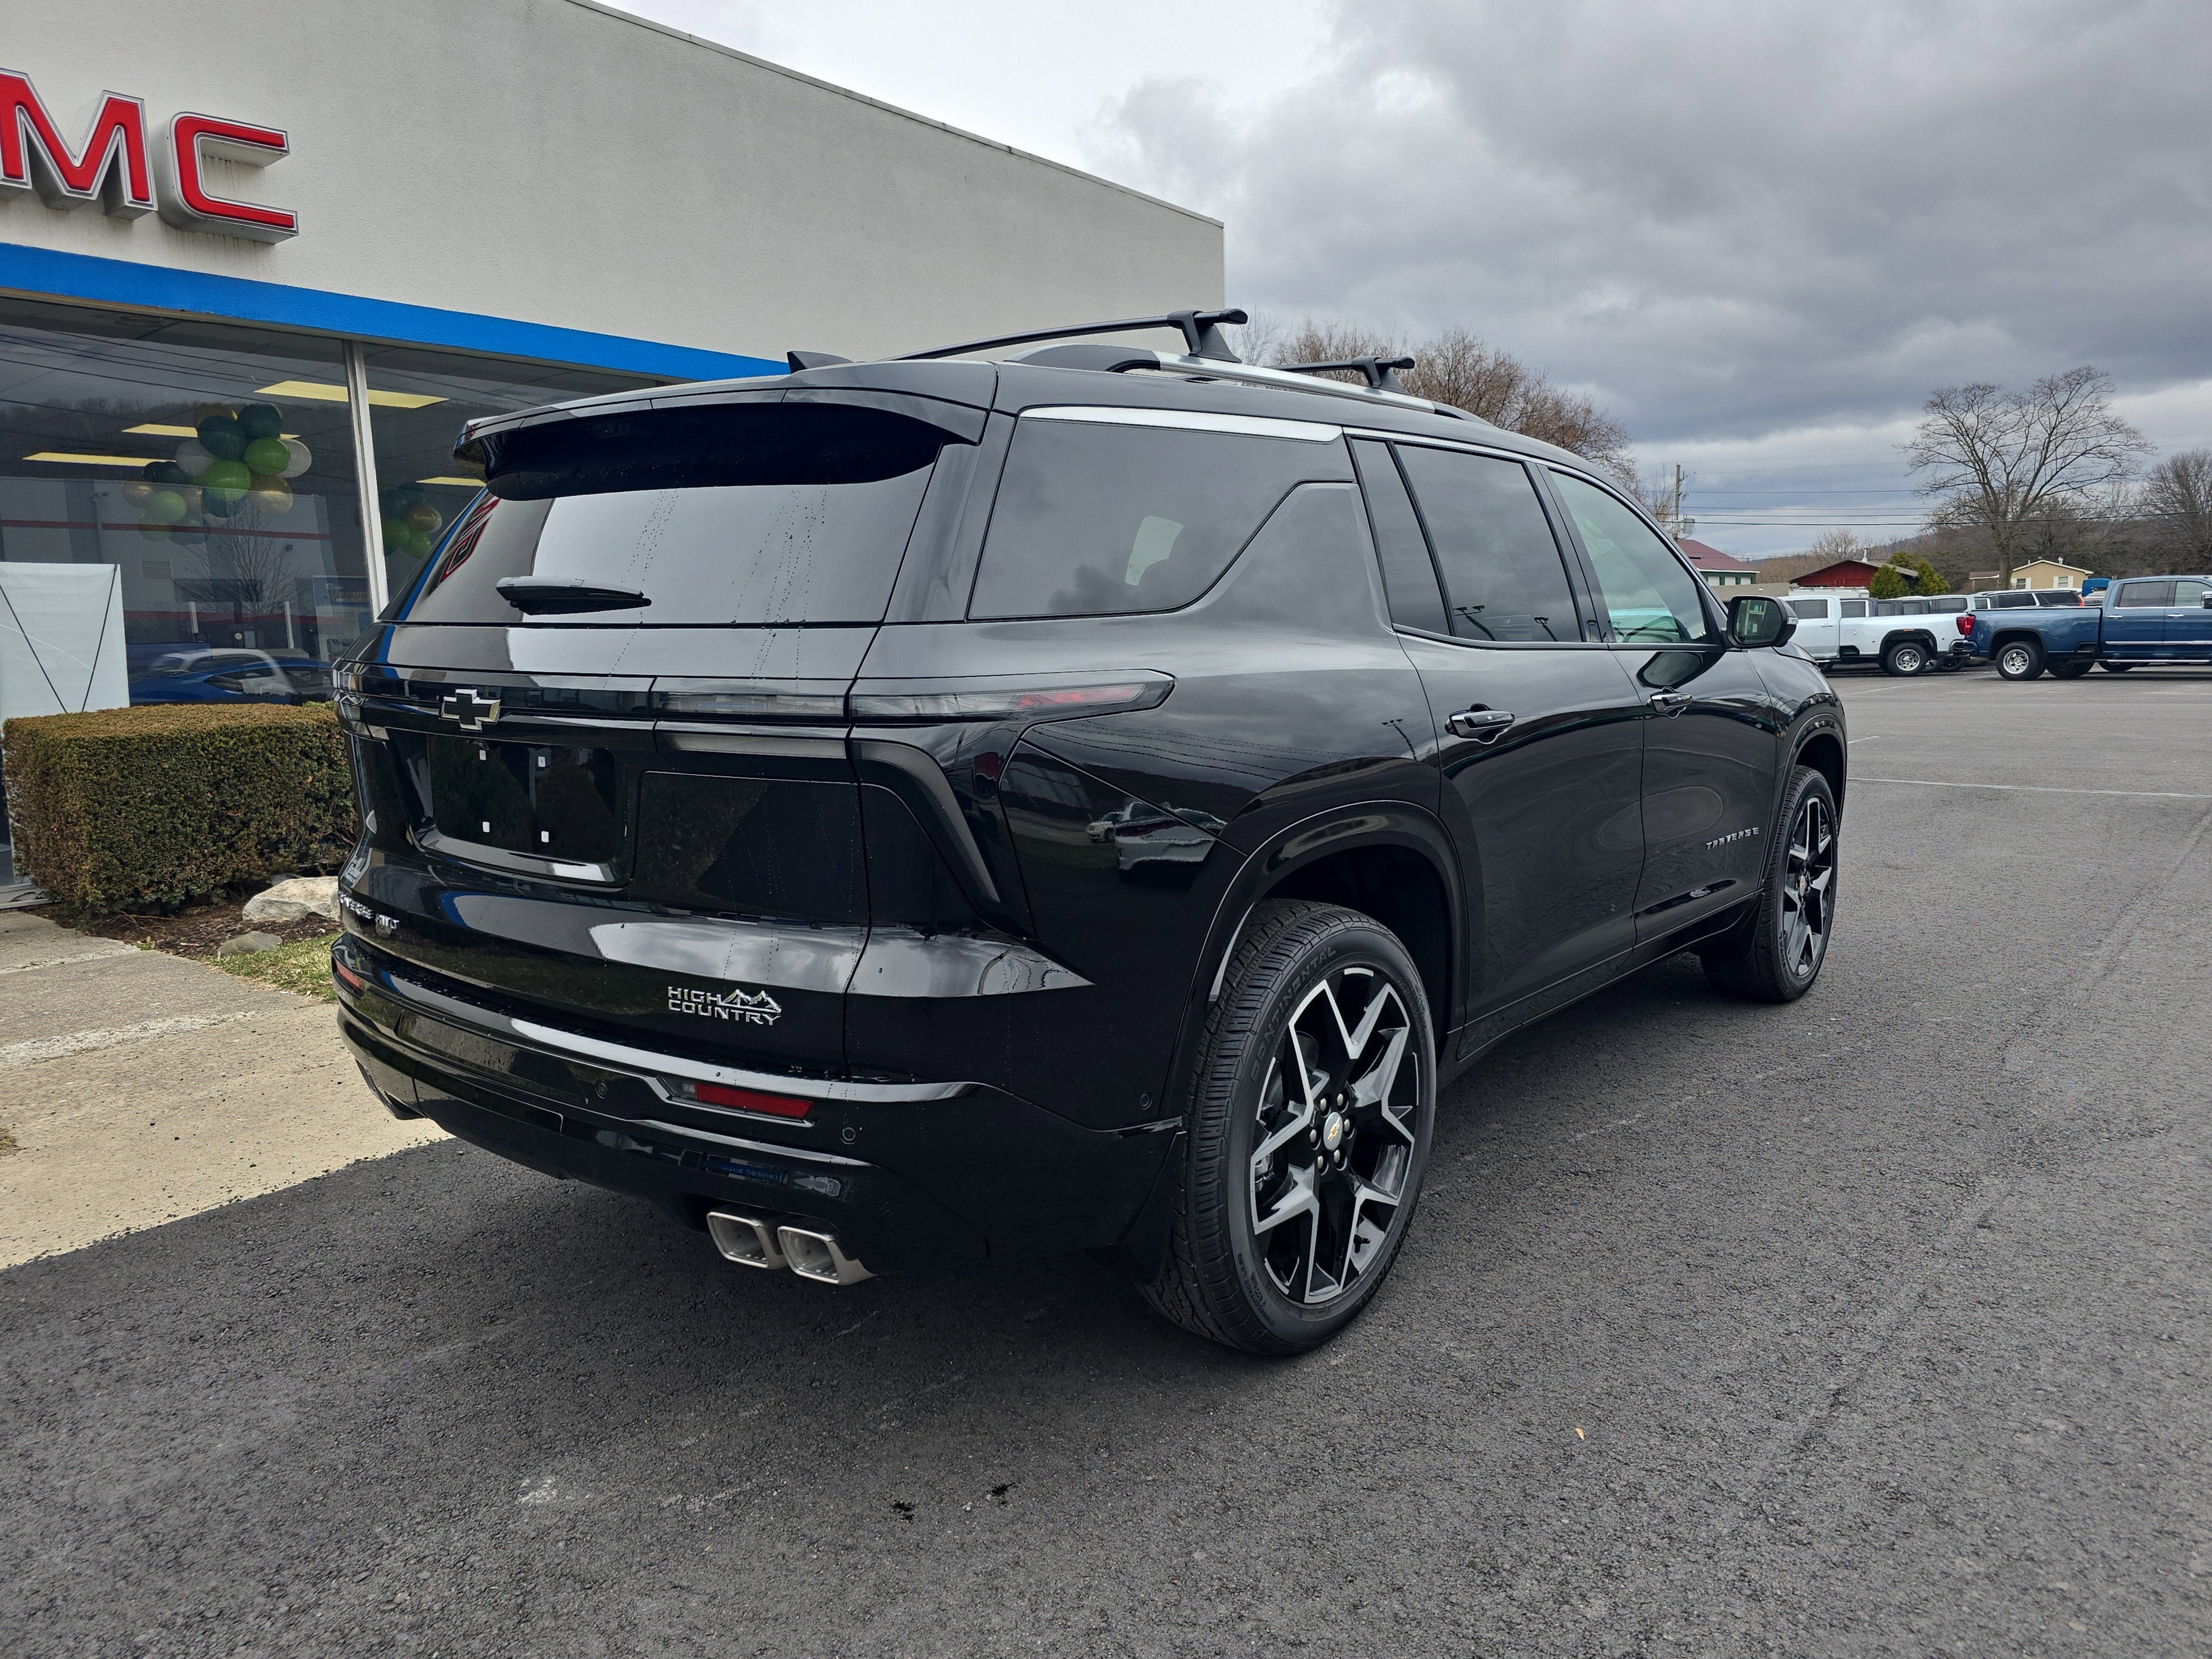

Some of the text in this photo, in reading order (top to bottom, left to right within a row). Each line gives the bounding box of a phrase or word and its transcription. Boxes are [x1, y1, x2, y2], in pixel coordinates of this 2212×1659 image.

[1706, 827, 1759, 850] TRAVERSE
[668, 986, 722, 1004] HIGH
[668, 999, 782, 1025] COUNTRY
[1250, 947, 1336, 1083] CONTINENTAL
